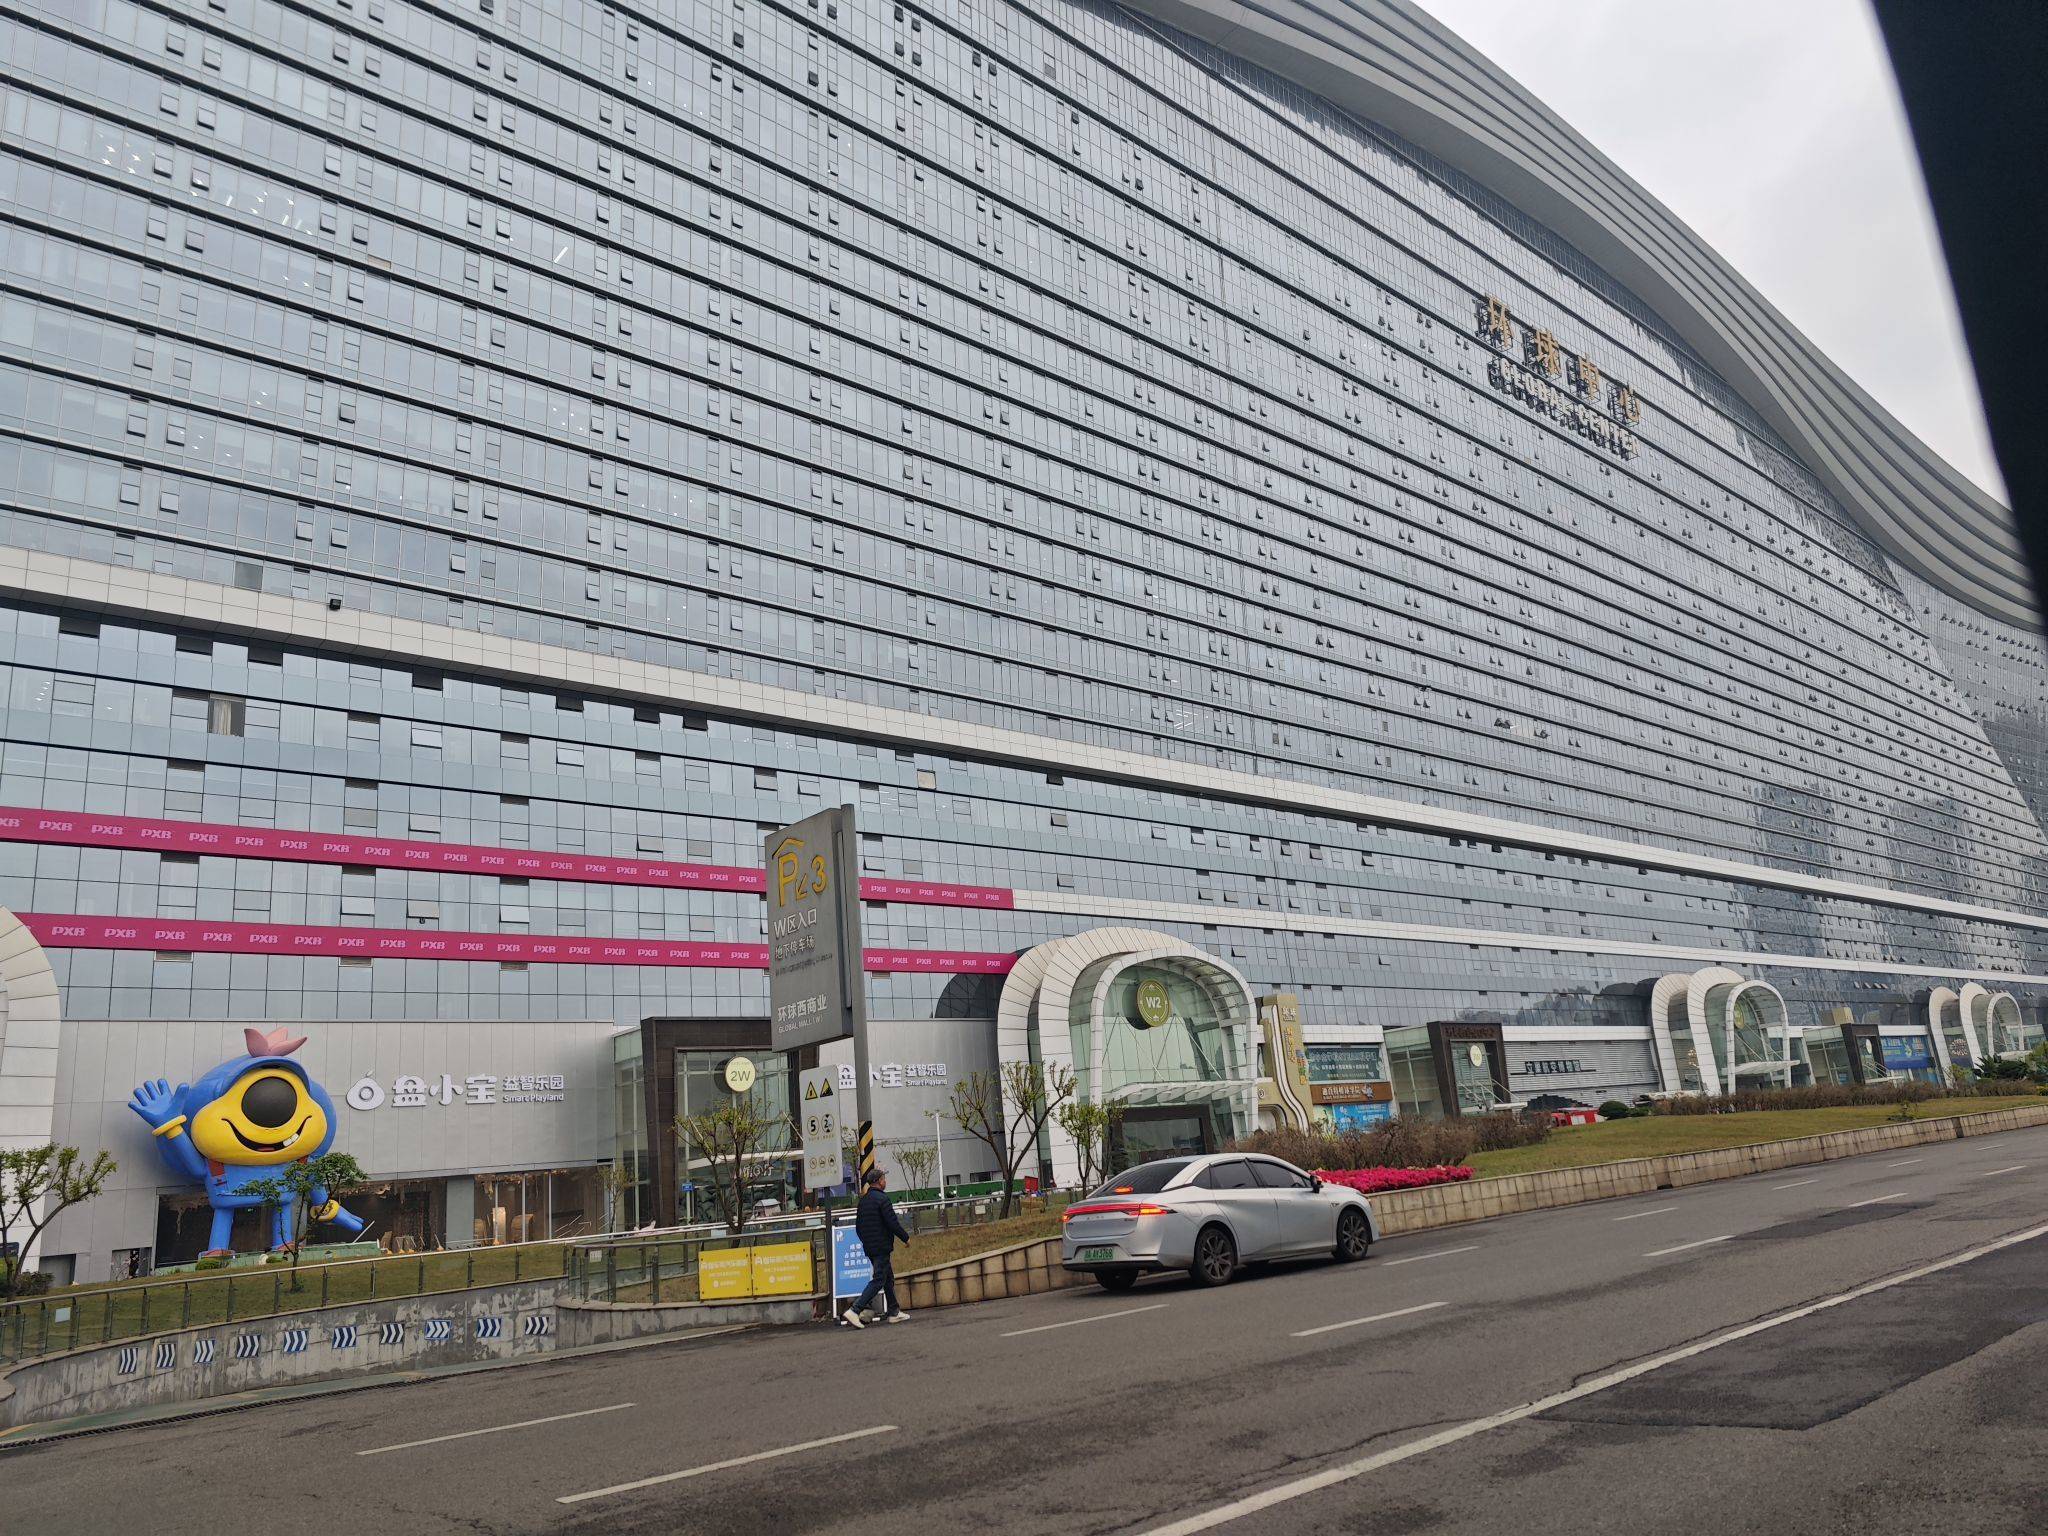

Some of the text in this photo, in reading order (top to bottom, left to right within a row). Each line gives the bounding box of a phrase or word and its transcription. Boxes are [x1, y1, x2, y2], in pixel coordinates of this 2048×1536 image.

[0, 818, 21, 828] XB
[39, 820, 73, 831] PXB
[91, 824, 127, 835] PXB
[140, 828, 172, 840] PXB
[188, 832, 219, 843] PXB
[235, 836, 264, 846] PXB
[279, 839, 311, 850] PXB
[323, 843, 350, 853] PXB
[364, 846, 391, 856] PXB
[404, 850, 430, 859] PXB
[443, 852, 468, 862] PXB
[481, 855, 505, 865] PXB
[517, 858, 540, 868] PXB
[550, 861, 573, 870] PXB
[585, 864, 607, 873] PXB
[616, 866, 638, 875] PXB
[648, 868, 671, 877] PXB
[679, 871, 699, 879] PXB
[709, 873, 729, 881] PXB
[738, 875, 757, 883] PXB
[777, 852, 828, 907] P 3
[773, 907, 817, 940] W区入口
[51, 926, 86, 937] PXB
[104, 928, 137, 938] PXB
[154, 930, 186, 940] PXB
[202, 932, 233, 942] PXB
[249, 934, 279, 944] PXB
[294, 936, 322, 945] PXB
[337, 937, 365, 947] PXB
[380, 939, 406, 948] PXB
[420, 940, 446, 950] PXB
[459, 942, 484, 951] PXB
[497, 943, 521, 952] PXB
[533, 945, 556, 954] PXB
[568, 946, 591, 955] PXB
[604, 947, 626, 956] PXB
[637, 948, 658, 957] PXB
[669, 949, 690, 958] PXB
[700, 951, 720, 959] PXB
[730, 951, 750, 959] PXB
[774, 935, 815, 960] 地下停车场
[777, 993, 828, 1022] 环球西商业
[1145, 996, 1162, 1009] W2
[729, 1070, 751, 1082] 2W
[905, 1062, 947, 1077] 益智乐园
[391, 1073, 564, 1107] 盘小宝 益智乐园
[503, 1092, 564, 1104] Smart Playland
[810, 1119, 816, 1132] 5
